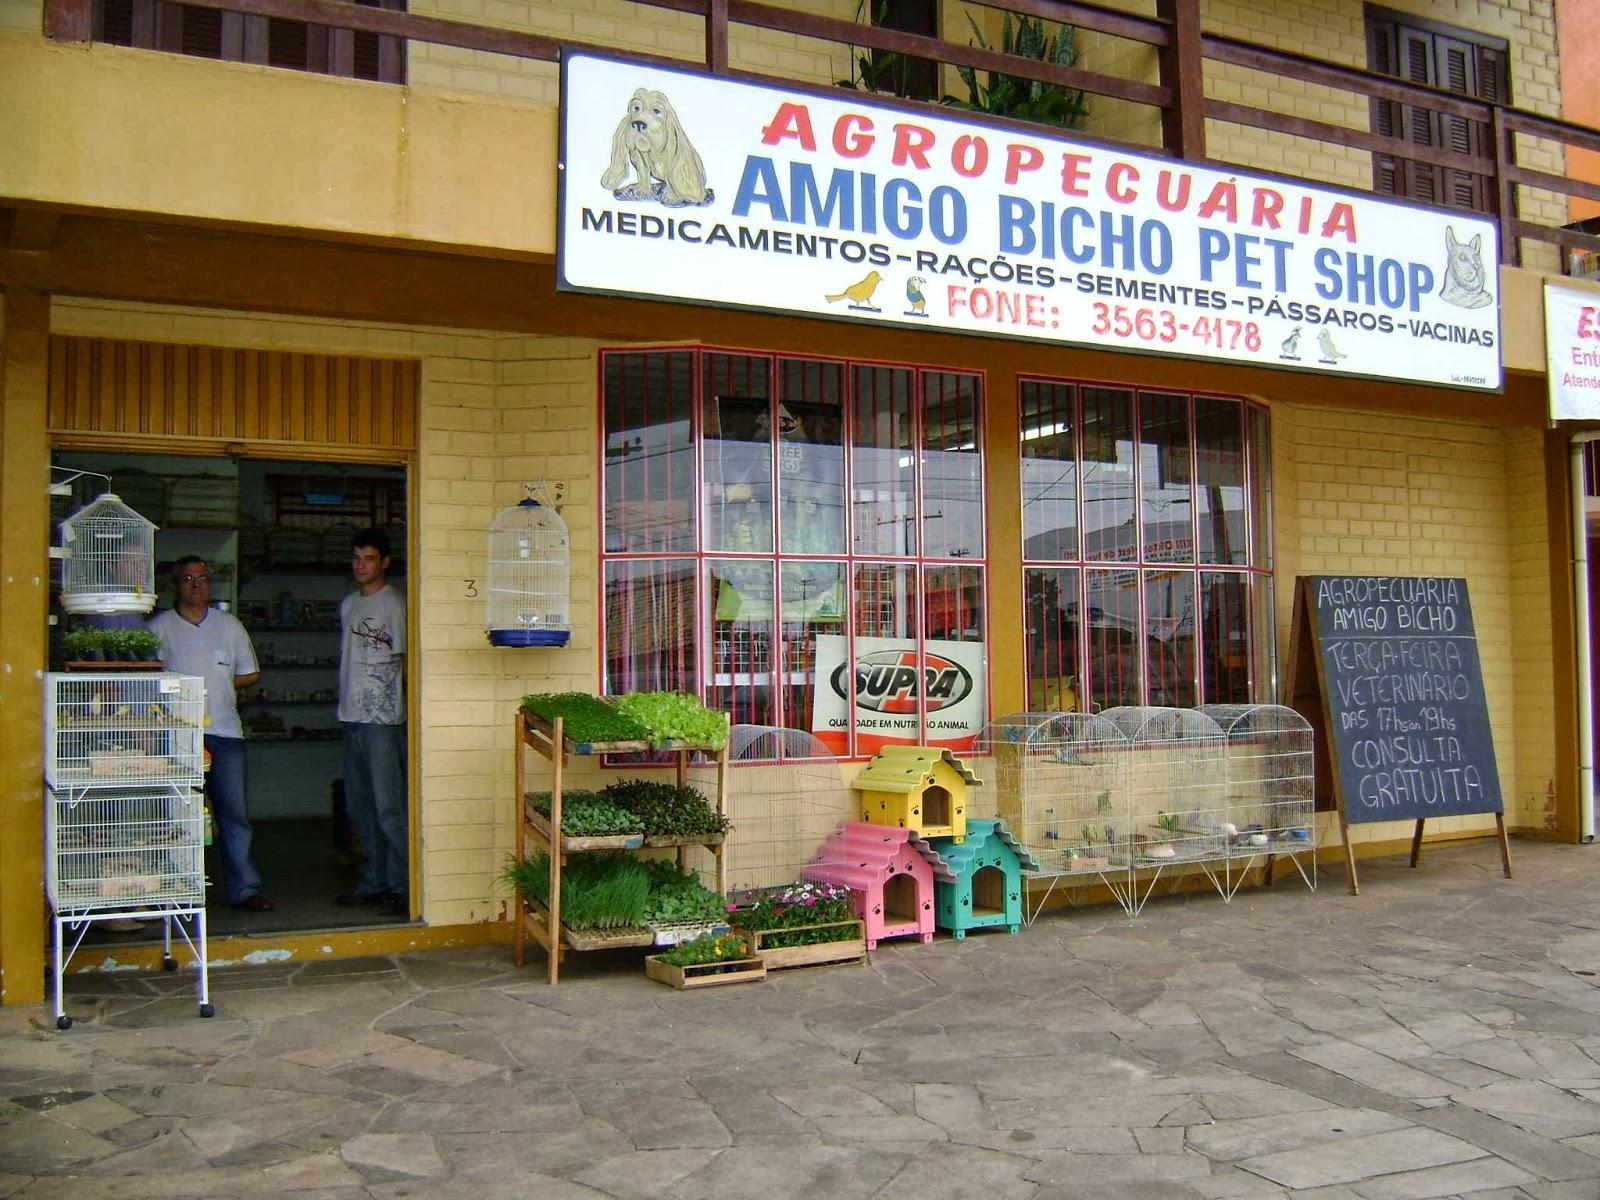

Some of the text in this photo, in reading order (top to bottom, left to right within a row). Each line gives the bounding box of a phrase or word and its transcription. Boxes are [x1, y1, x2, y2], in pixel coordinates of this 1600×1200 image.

[761, 102, 1359, 243] AGROPECUÁRIA
[731, 154, 1435, 313] AMIGO BICHO PET SHOP
[946, 284, 1263, 354] FONE: 3563-4178
[464, 579, 478, 598] 3
[1333, 601, 1456, 632] AMIGO BICHO
[847, 663, 959, 698] SUPRA
[1337, 671, 1469, 707] VETERINÁRIO
[828, 719, 878, 729] QUADADE
[879, 720, 892, 729] EM
[937, 721, 970, 730] ANIMAL
[1341, 709, 1368, 731] DAS
[1351, 737, 1462, 769] CONSULTA
[1359, 765, 1484, 808] GRATUITA
